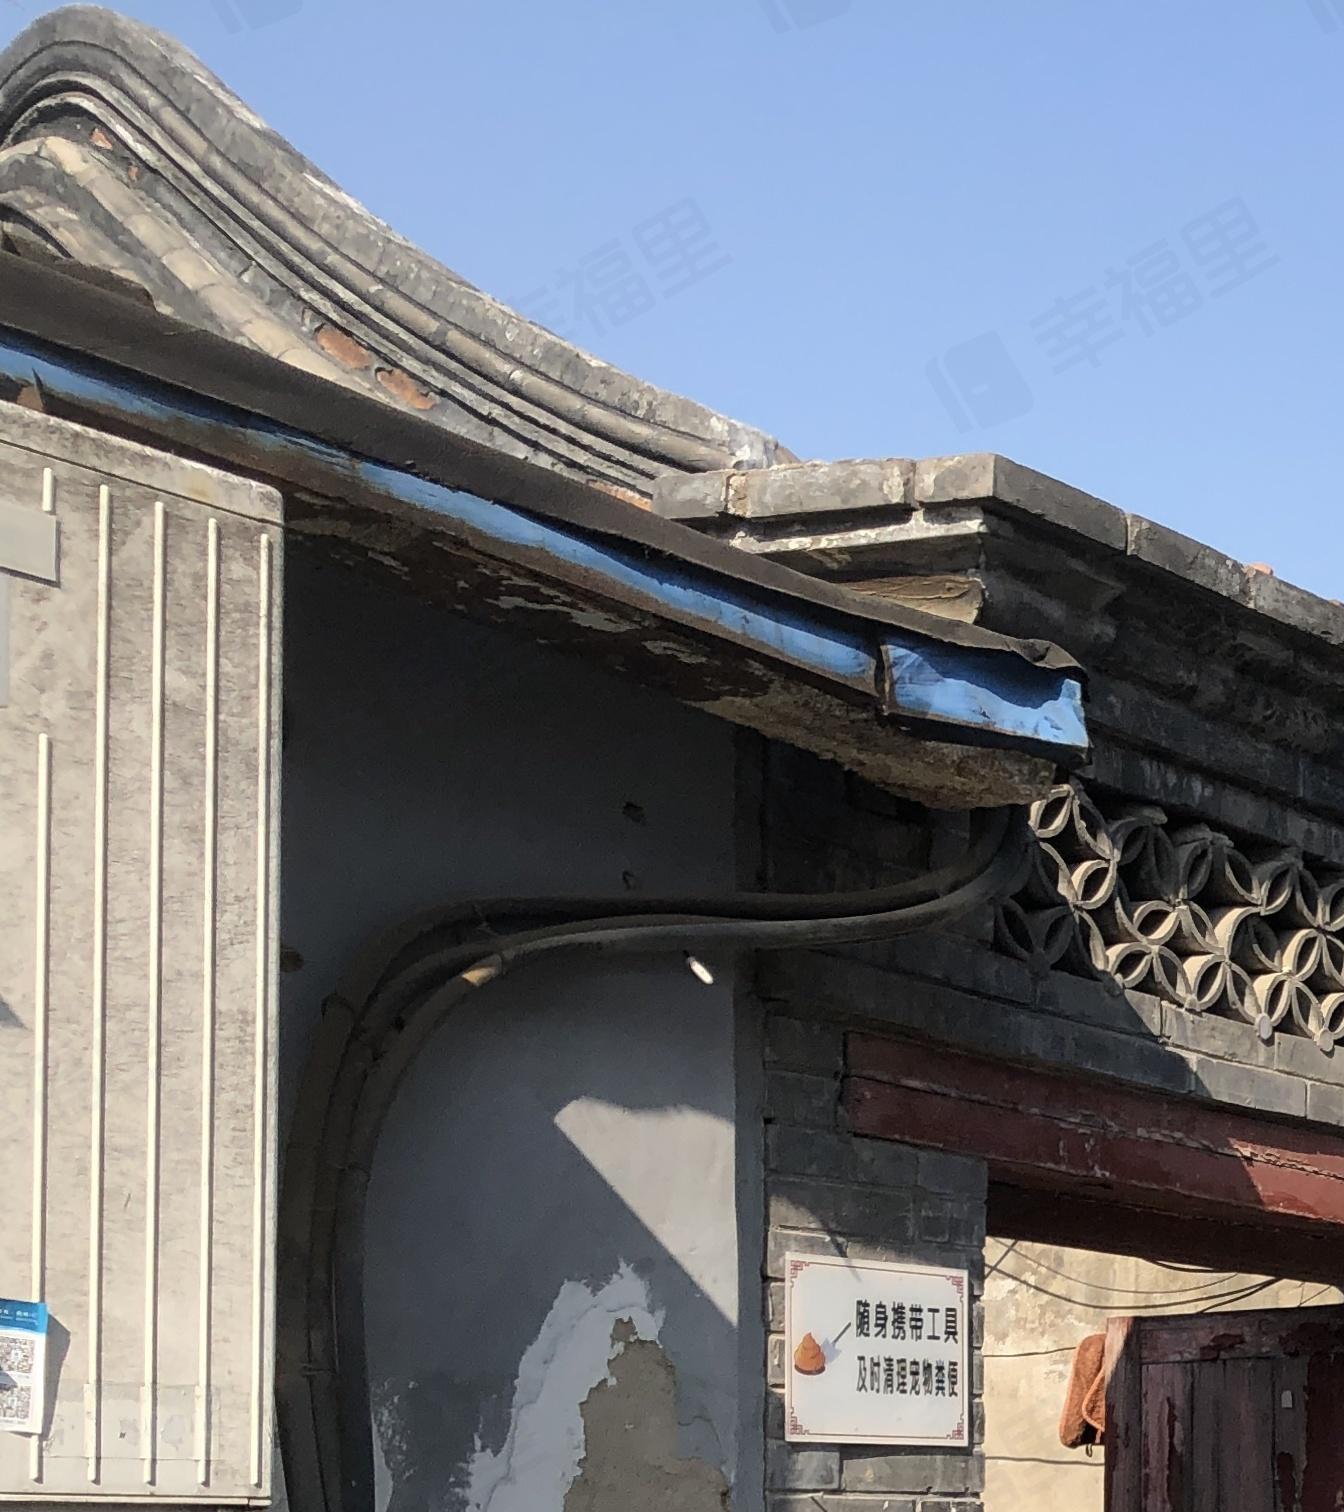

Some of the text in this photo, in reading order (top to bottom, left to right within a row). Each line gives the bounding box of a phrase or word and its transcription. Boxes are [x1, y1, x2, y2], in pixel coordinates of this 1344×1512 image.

[855, 1299, 959, 1345] 随身携带工具
[855, 1355, 959, 1398] 及时清理宠物粪便
